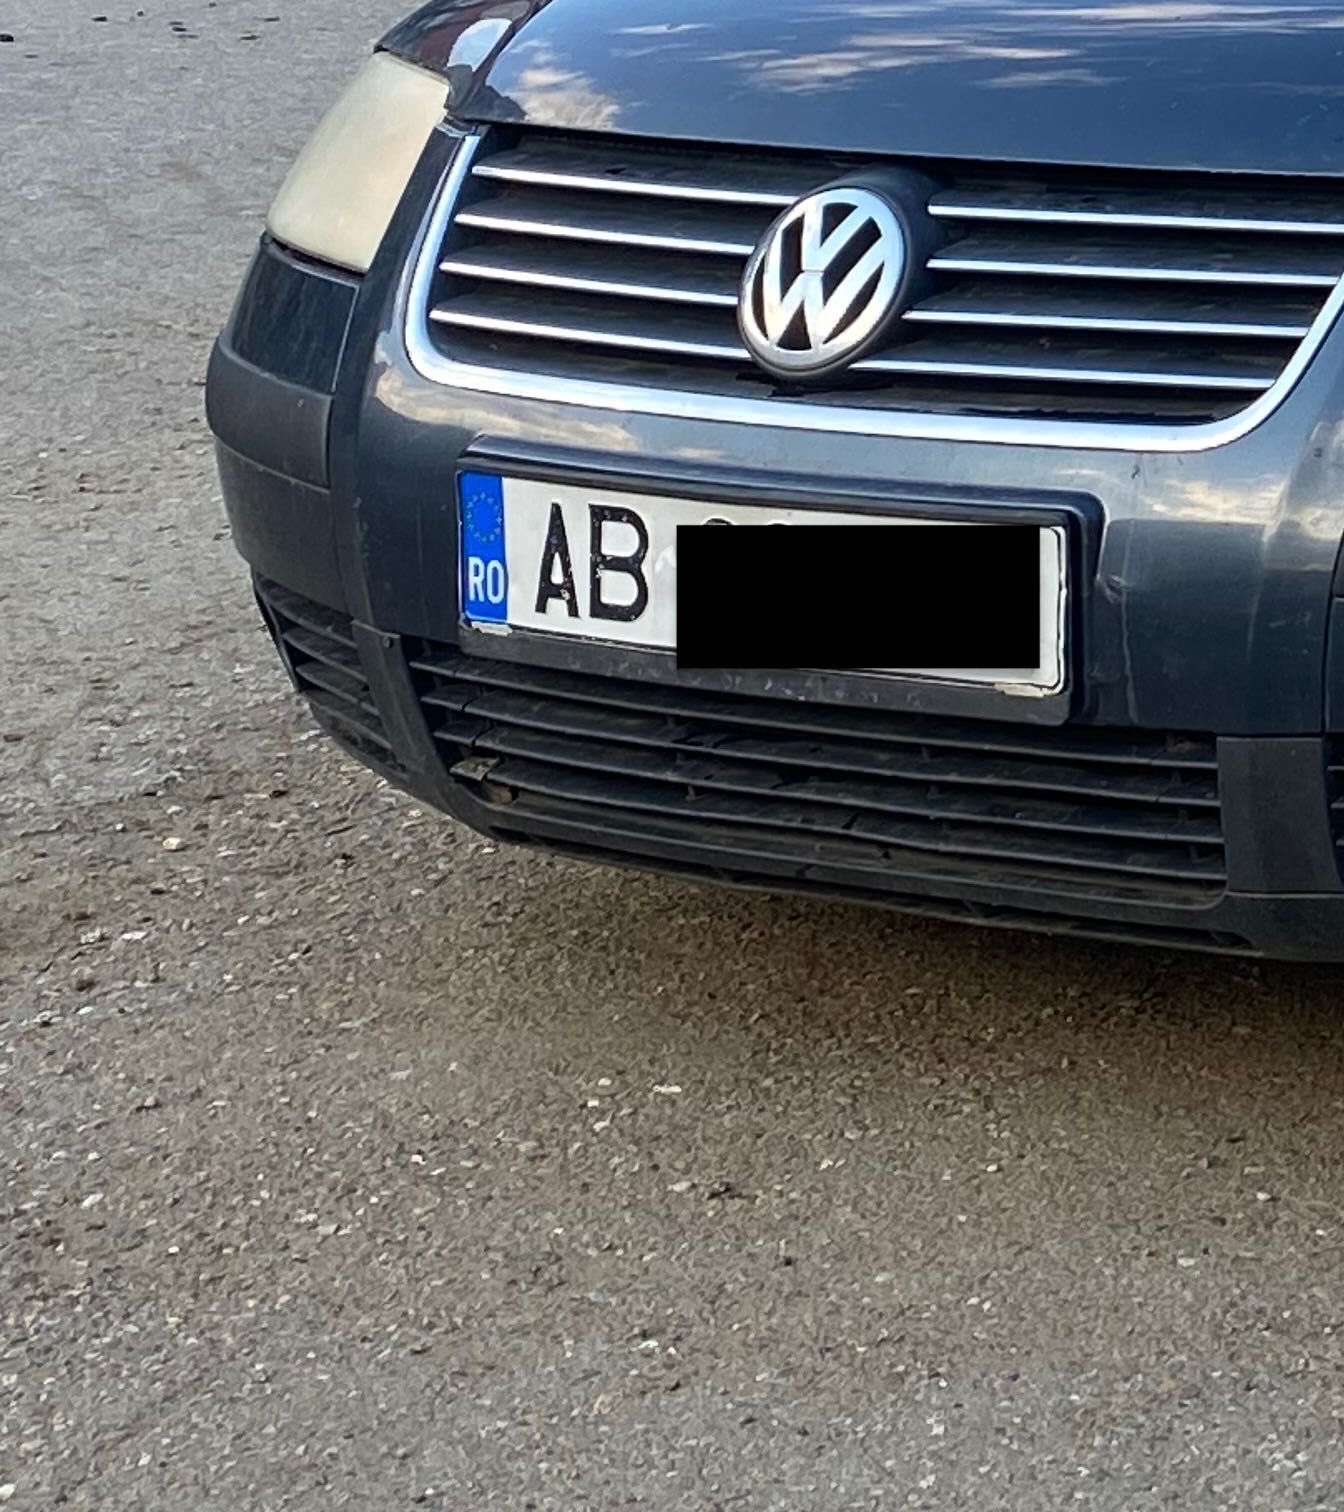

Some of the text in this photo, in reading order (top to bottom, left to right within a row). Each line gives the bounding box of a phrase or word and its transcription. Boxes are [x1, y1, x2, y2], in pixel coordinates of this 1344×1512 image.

[744, 190, 902, 364] VW
[468, 556, 504, 604] RO
[535, 502, 648, 622] AB
